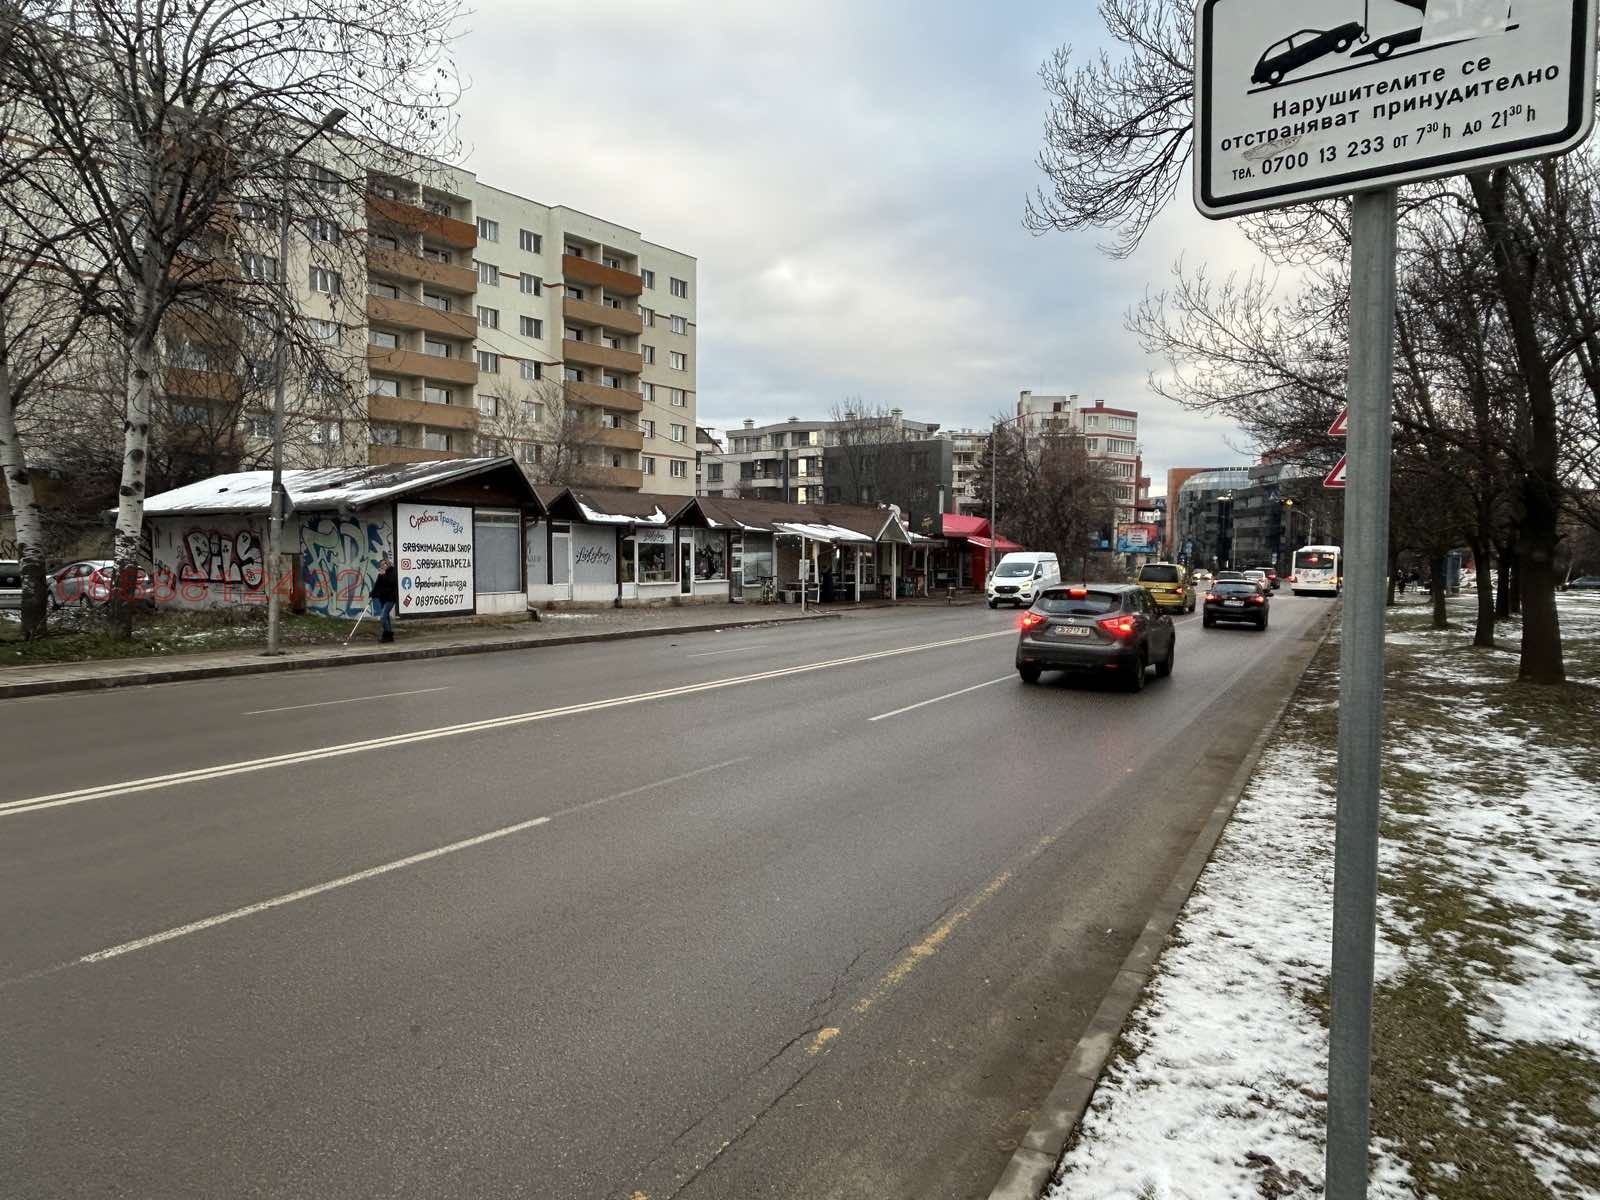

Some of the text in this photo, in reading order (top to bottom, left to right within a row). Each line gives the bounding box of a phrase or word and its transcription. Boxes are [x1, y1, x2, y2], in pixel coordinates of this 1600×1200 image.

[1221, 65, 1560, 151] отстраняват принудително
[1273, 56, 1491, 119] Нарушителите се
[1232, 168, 1255, 181] тел.
[1262, 152, 1309, 175] 0700
[1319, 146, 1337, 163] 13
[1347, 136, 1384, 157] 233
[1393, 135, 1408, 148] от
[1462, 120, 1482, 137] до
[416, 595, 464, 607] 0897666677
